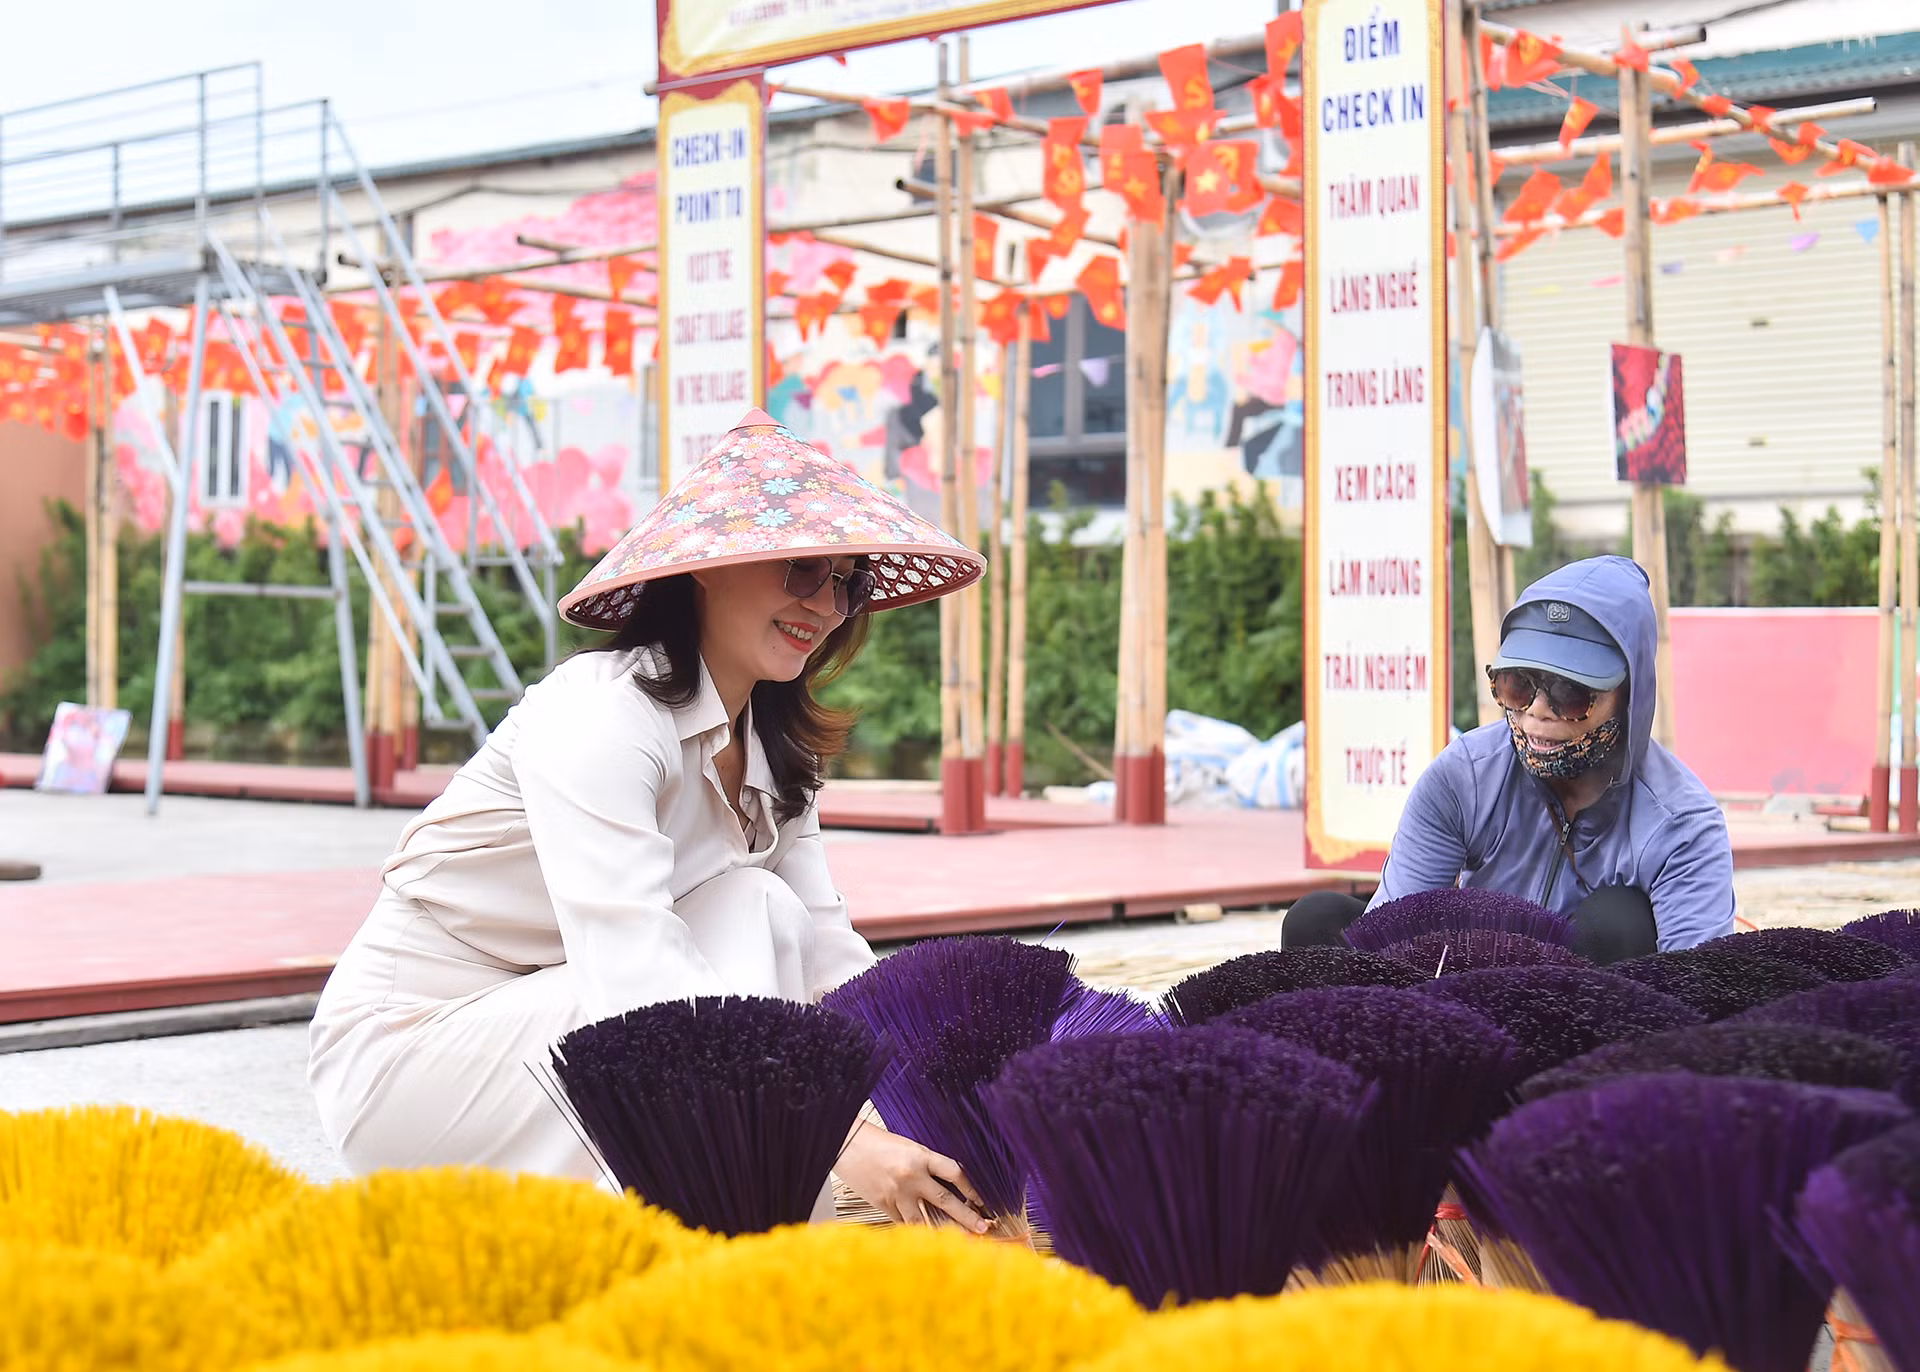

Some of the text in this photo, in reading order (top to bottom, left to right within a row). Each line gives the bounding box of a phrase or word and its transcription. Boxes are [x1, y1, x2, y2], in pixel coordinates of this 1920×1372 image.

[1323, 84, 1424, 132] CHECK IN
[674, 128, 745, 168] CHECK-IN
[1377, 174, 1419, 218] QUAN
[1326, 368, 1378, 408] TRONG
[1335, 464, 1368, 501] XEM
